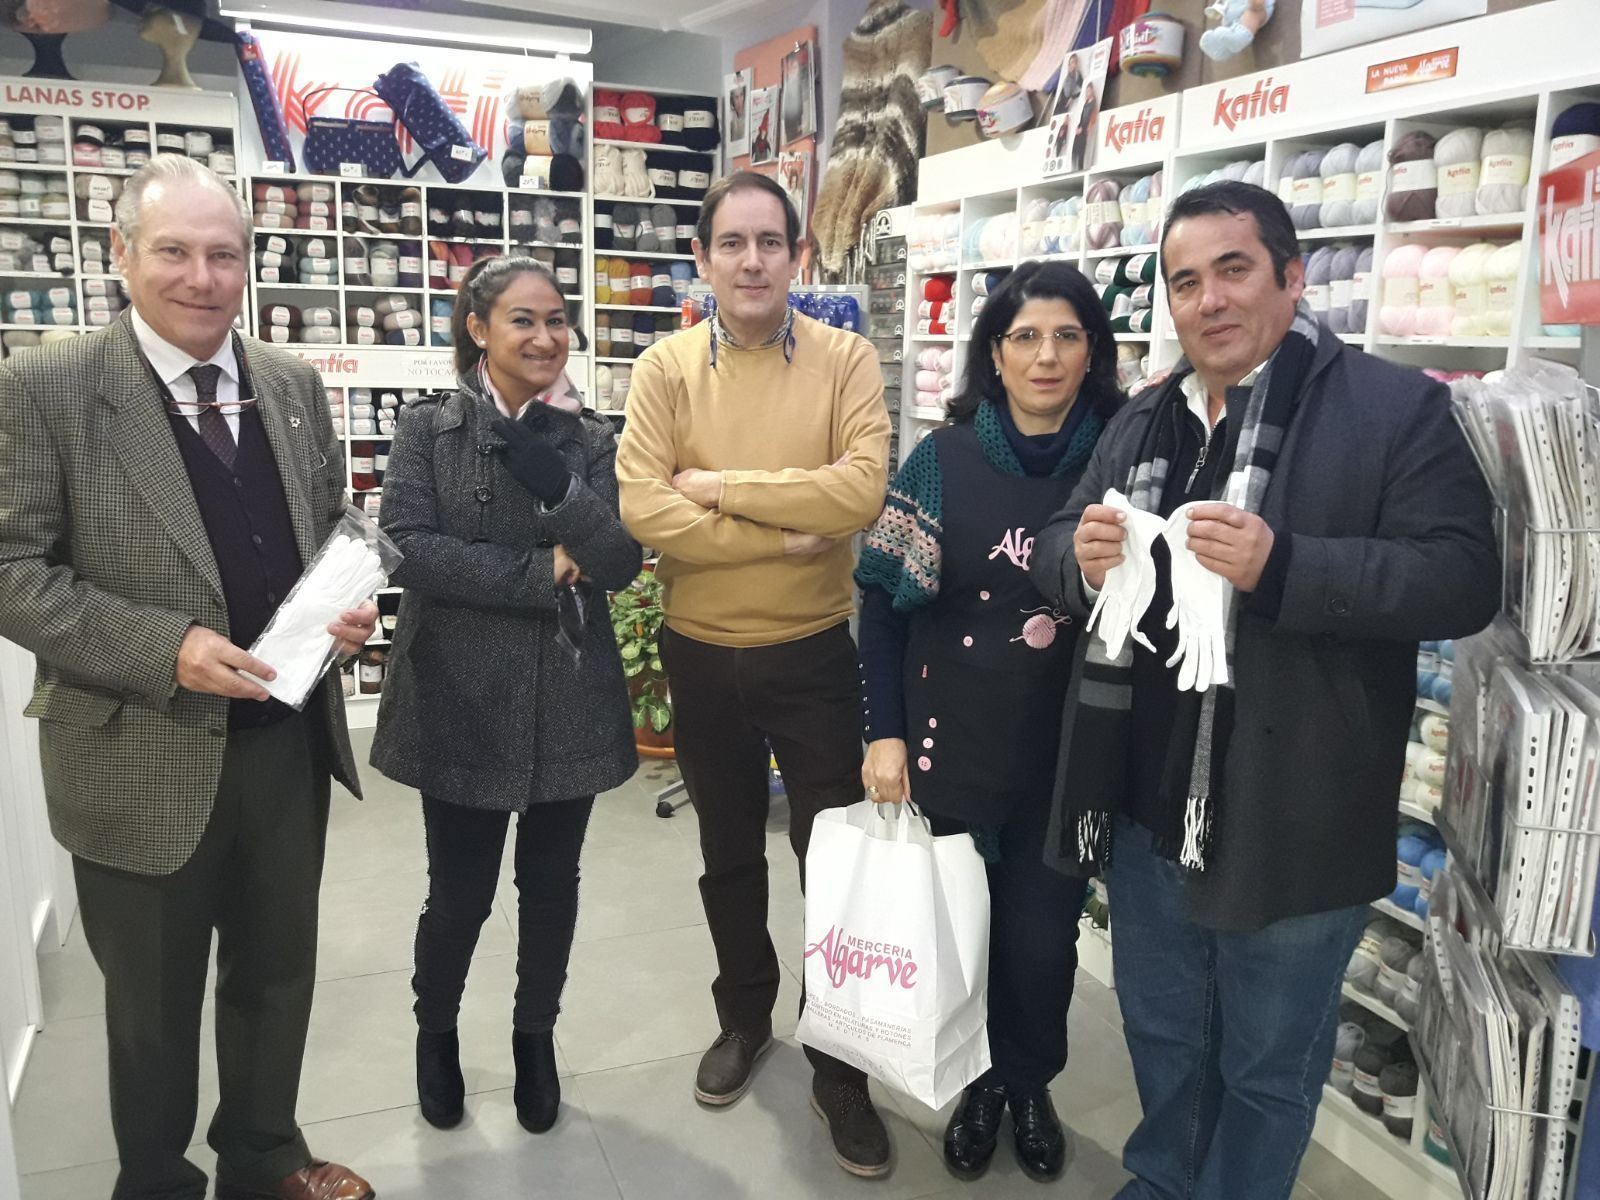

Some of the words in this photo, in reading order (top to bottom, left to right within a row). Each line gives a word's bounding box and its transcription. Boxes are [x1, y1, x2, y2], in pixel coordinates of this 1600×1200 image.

[1383, 63, 1409, 76] NUEVA
[5, 85, 84, 106] LANAS
[91, 90, 150, 111] STOP
[1213, 77, 1291, 132] katia
[1104, 108, 1166, 153] katia
[804, 924, 919, 990] Algarve
[847, 935, 914, 960] MERCERIA
